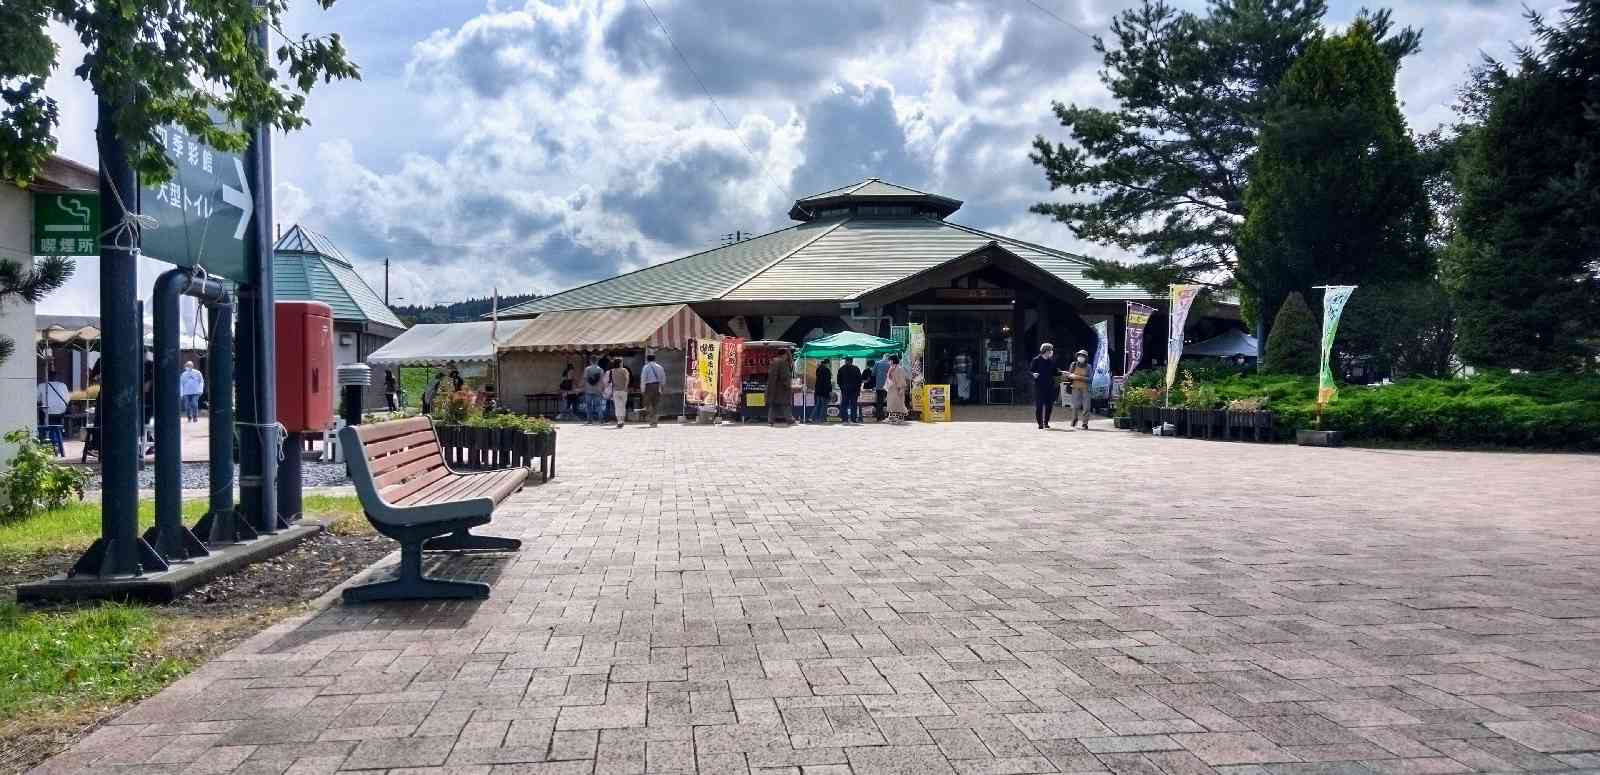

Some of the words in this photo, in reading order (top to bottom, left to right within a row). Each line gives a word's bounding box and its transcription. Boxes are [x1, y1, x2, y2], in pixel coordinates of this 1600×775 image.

[156, 181, 214, 219] 大型トイレ
[40, 237, 95, 256] 喫煙所
